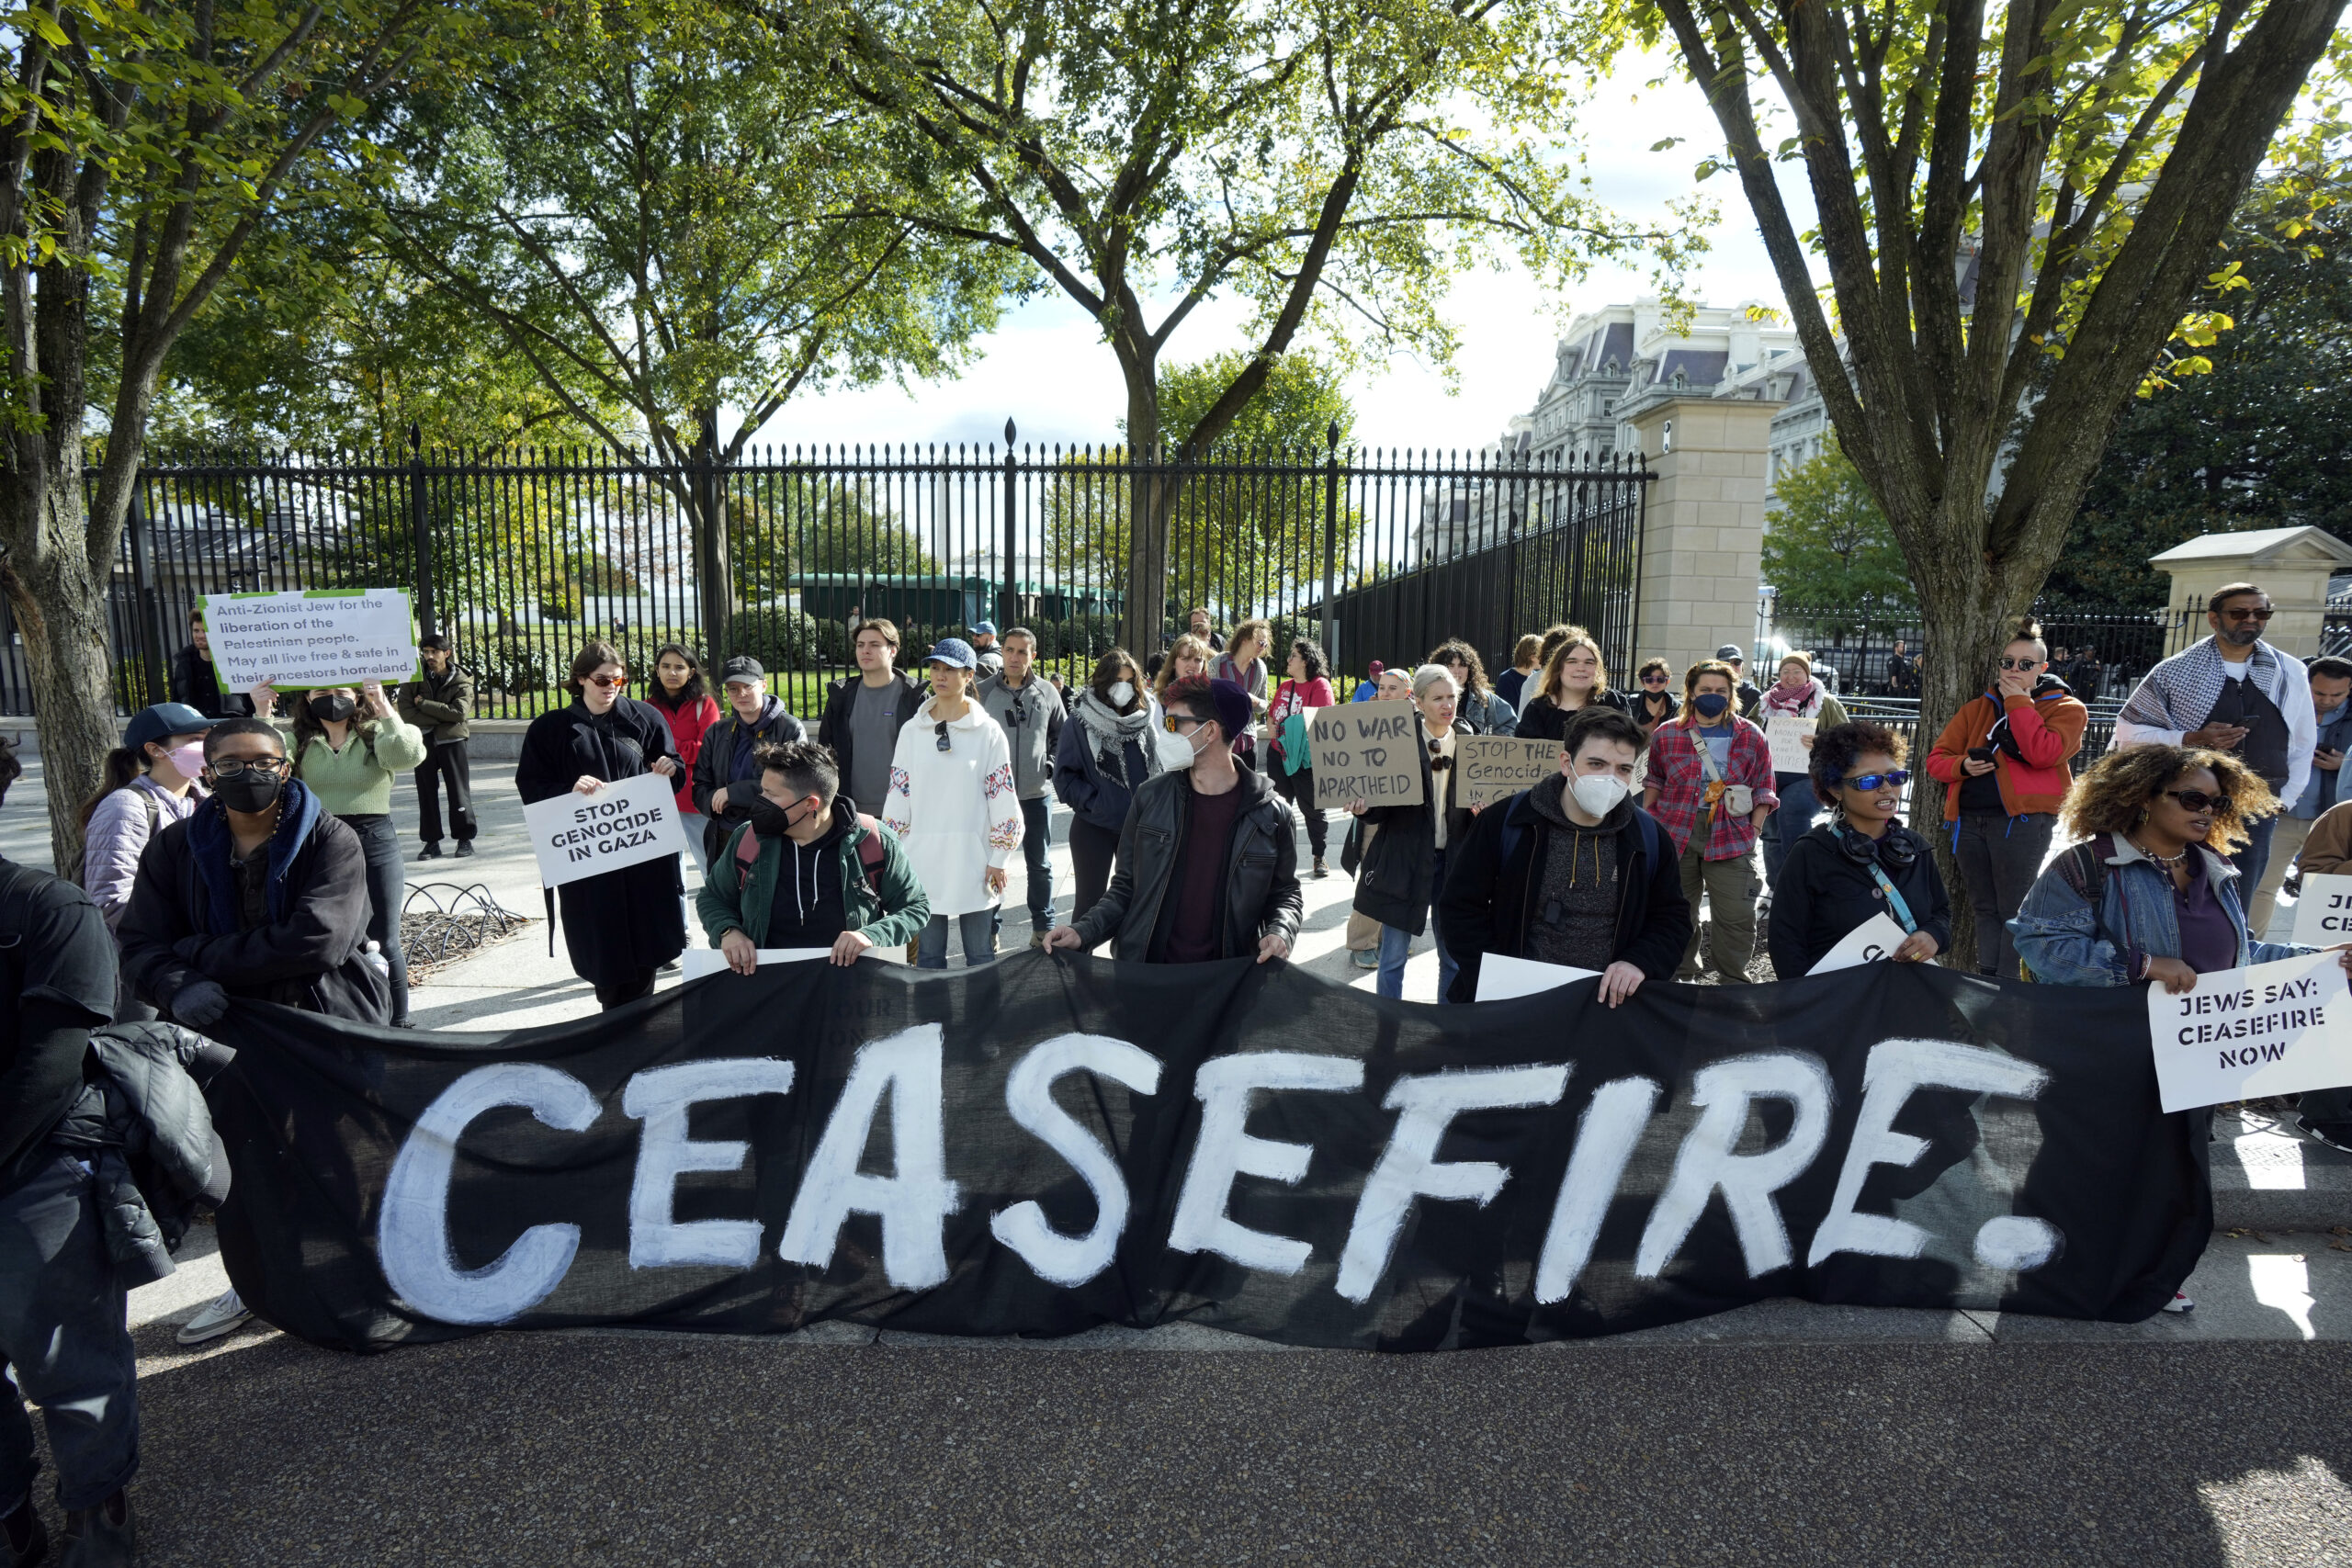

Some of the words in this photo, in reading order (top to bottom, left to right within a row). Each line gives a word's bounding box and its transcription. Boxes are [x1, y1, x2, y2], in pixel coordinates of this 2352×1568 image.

[217, 602, 303, 616] Anti-Zionist
[306, 600, 334, 613] Jew
[339, 599, 359, 610] for
[361, 598, 383, 609] the
[220, 620, 289, 634] liberation
[293, 618, 310, 629] of
[311, 618, 334, 629] the
[223, 636, 303, 650] Palestinian
[307, 633, 360, 648] people.
[227, 656, 257, 669] May
[261, 653, 278, 665] all
[282, 651, 307, 663] live
[311, 650, 338, 662] free
[341, 649, 352, 660] &
[355, 647, 383, 659] safe
[387, 646, 400, 658] in
[231, 671, 266, 684] their
[268, 667, 337, 682] ancestors
[340, 661, 413, 676] homeland.
[1314, 719, 1347, 742] NO
[1357, 716, 1412, 740] WAR
[1323, 750, 1350, 767] NO
[1360, 747, 1387, 768] TO
[1465, 741, 1518, 760] STOP
[1524, 742, 1556, 761] THE
[1467, 762, 1552, 779] Genocide
[1318, 774, 1412, 798] APARTHEID
[573, 798, 630, 824] STOP
[568, 845, 593, 863] IN
[598, 829, 658, 854] GAZA
[2179, 988, 2256, 1017] JEWS
[2264, 977, 2318, 1005] SAY:
[2177, 1007, 2325, 1046] CEASEFIRE
[2220, 1042, 2287, 1069] NOW
[379, 1021, 2066, 1325] CEASEFIRE.
